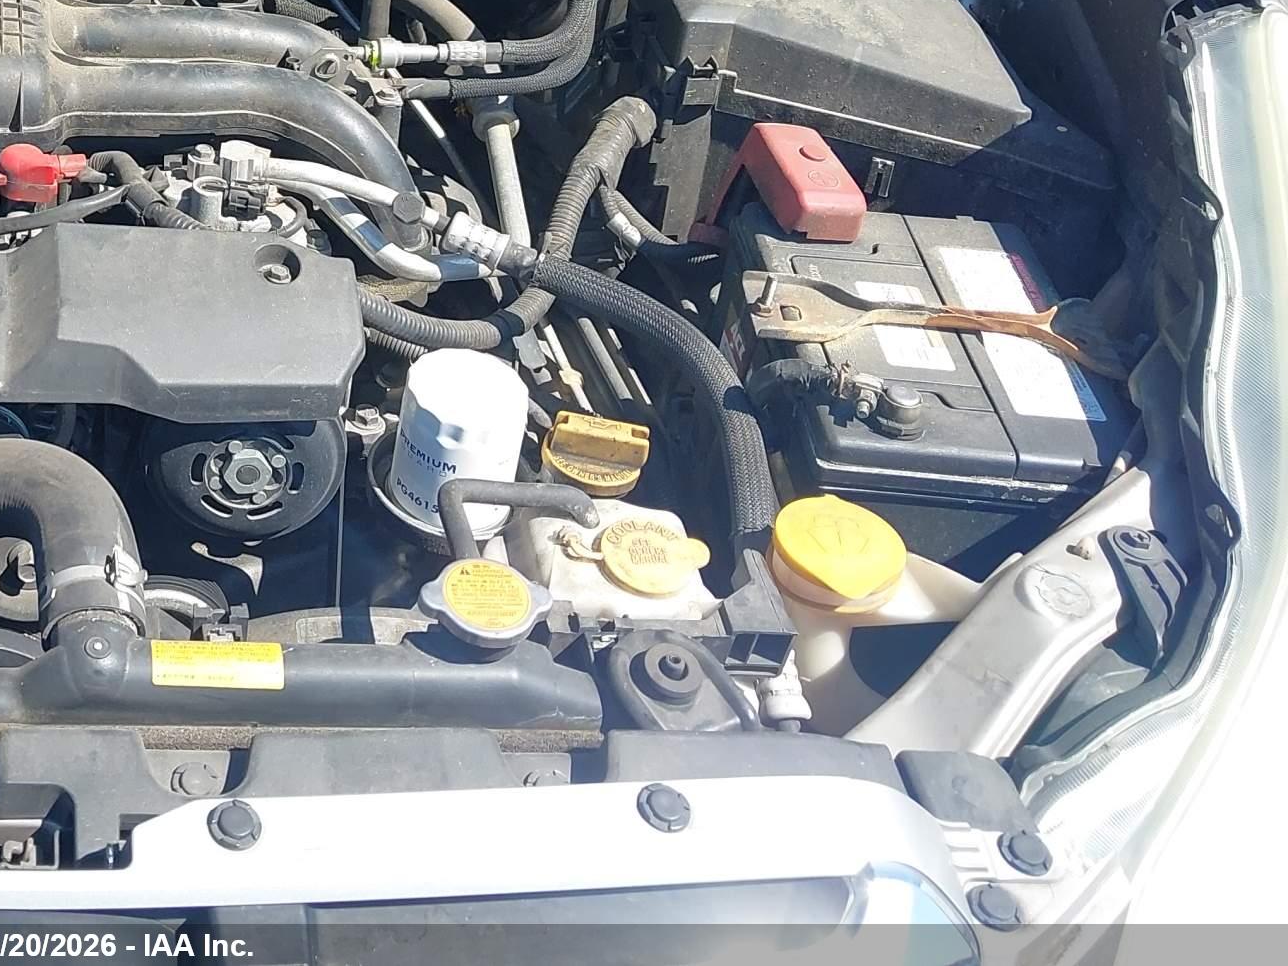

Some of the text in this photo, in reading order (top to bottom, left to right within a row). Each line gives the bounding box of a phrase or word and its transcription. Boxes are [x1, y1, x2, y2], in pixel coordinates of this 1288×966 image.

[400, 426, 457, 475] PREMIUM
[396, 476, 440, 514] PG4615
[606, 520, 679, 545] COOLANT
